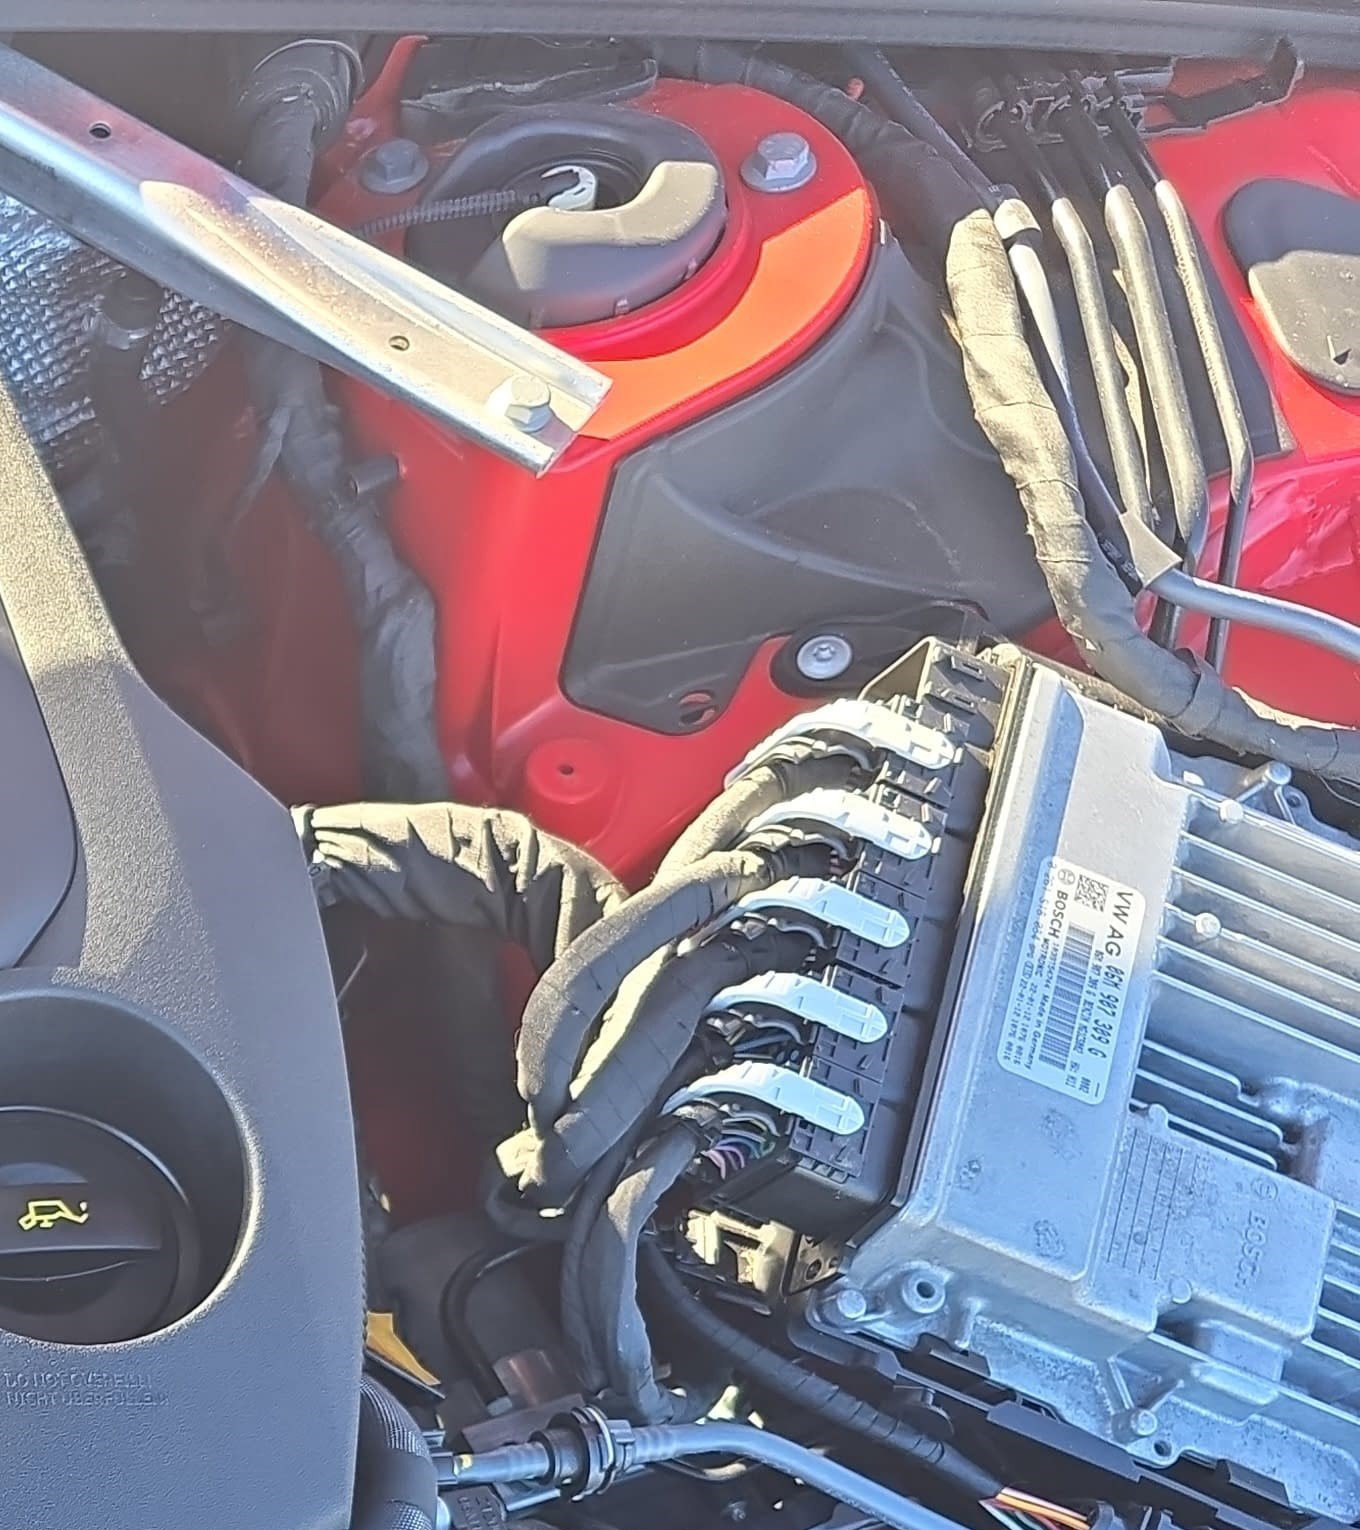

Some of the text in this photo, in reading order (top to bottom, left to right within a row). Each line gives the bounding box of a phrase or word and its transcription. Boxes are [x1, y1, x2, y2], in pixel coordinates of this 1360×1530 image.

[1048, 888, 1070, 940] BOSCH
[1113, 890, 1135, 925] VW
[1105, 925, 1126, 959] AG
[1098, 993, 1121, 1018] 907
[1093, 1018, 1114, 1045] 309
